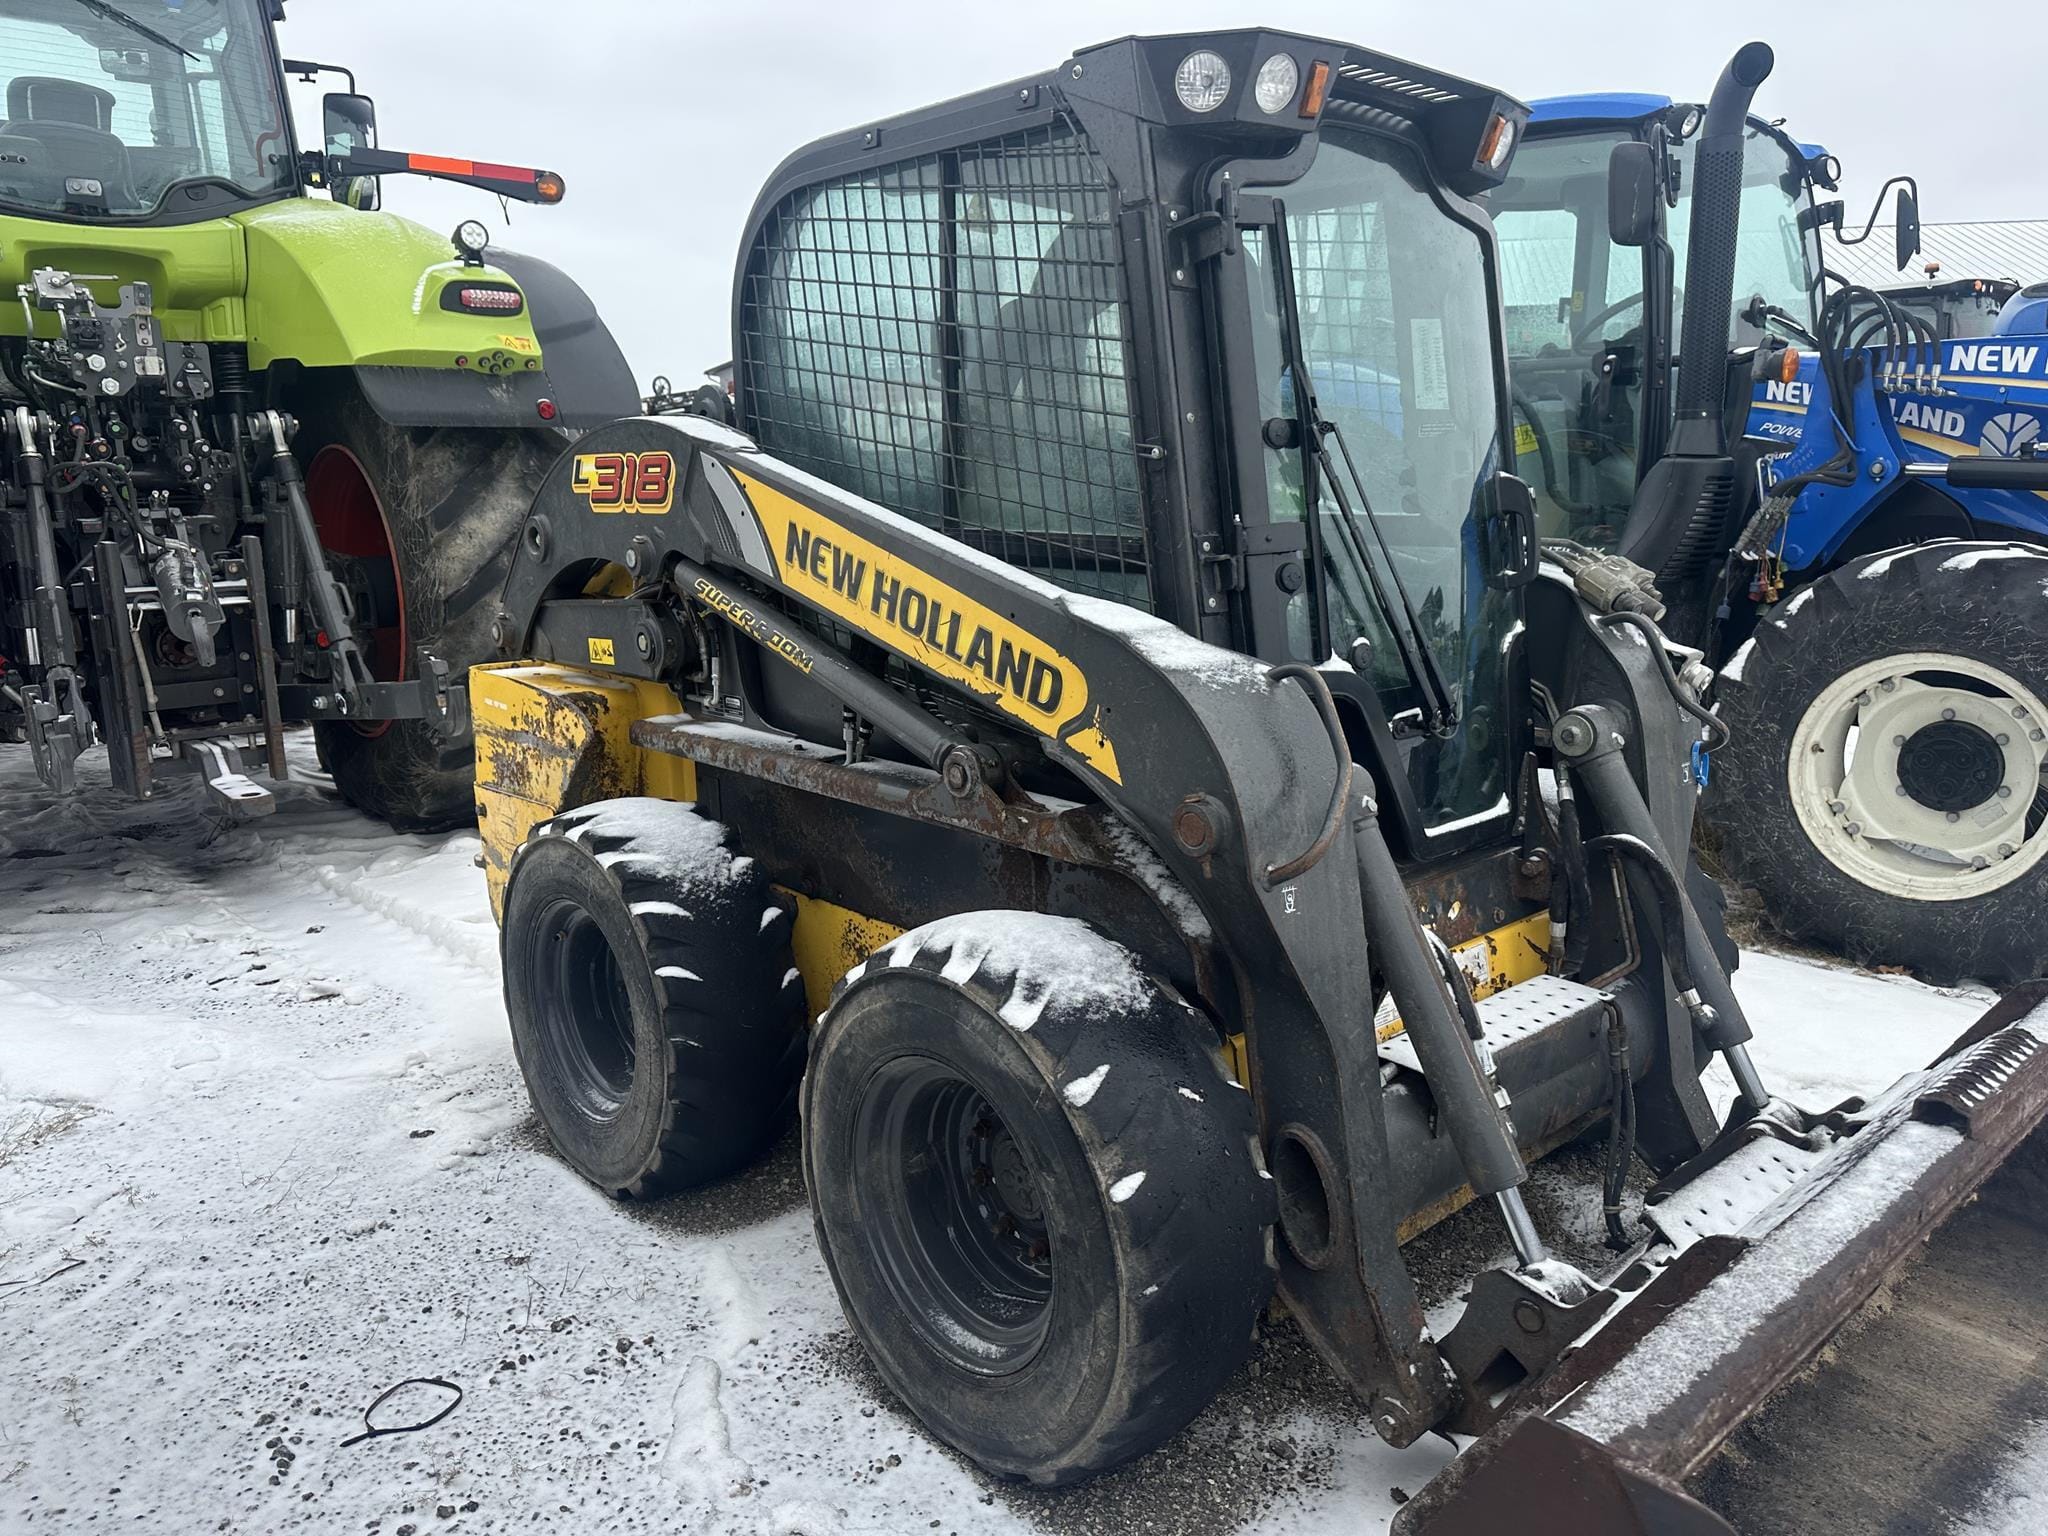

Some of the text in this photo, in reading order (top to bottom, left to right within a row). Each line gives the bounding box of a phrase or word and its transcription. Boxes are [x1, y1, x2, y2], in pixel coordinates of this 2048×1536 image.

[1950, 345, 2039, 373] NEW
[572, 451, 677, 514] L318
[785, 520, 1064, 716] NEW HOLLAND
